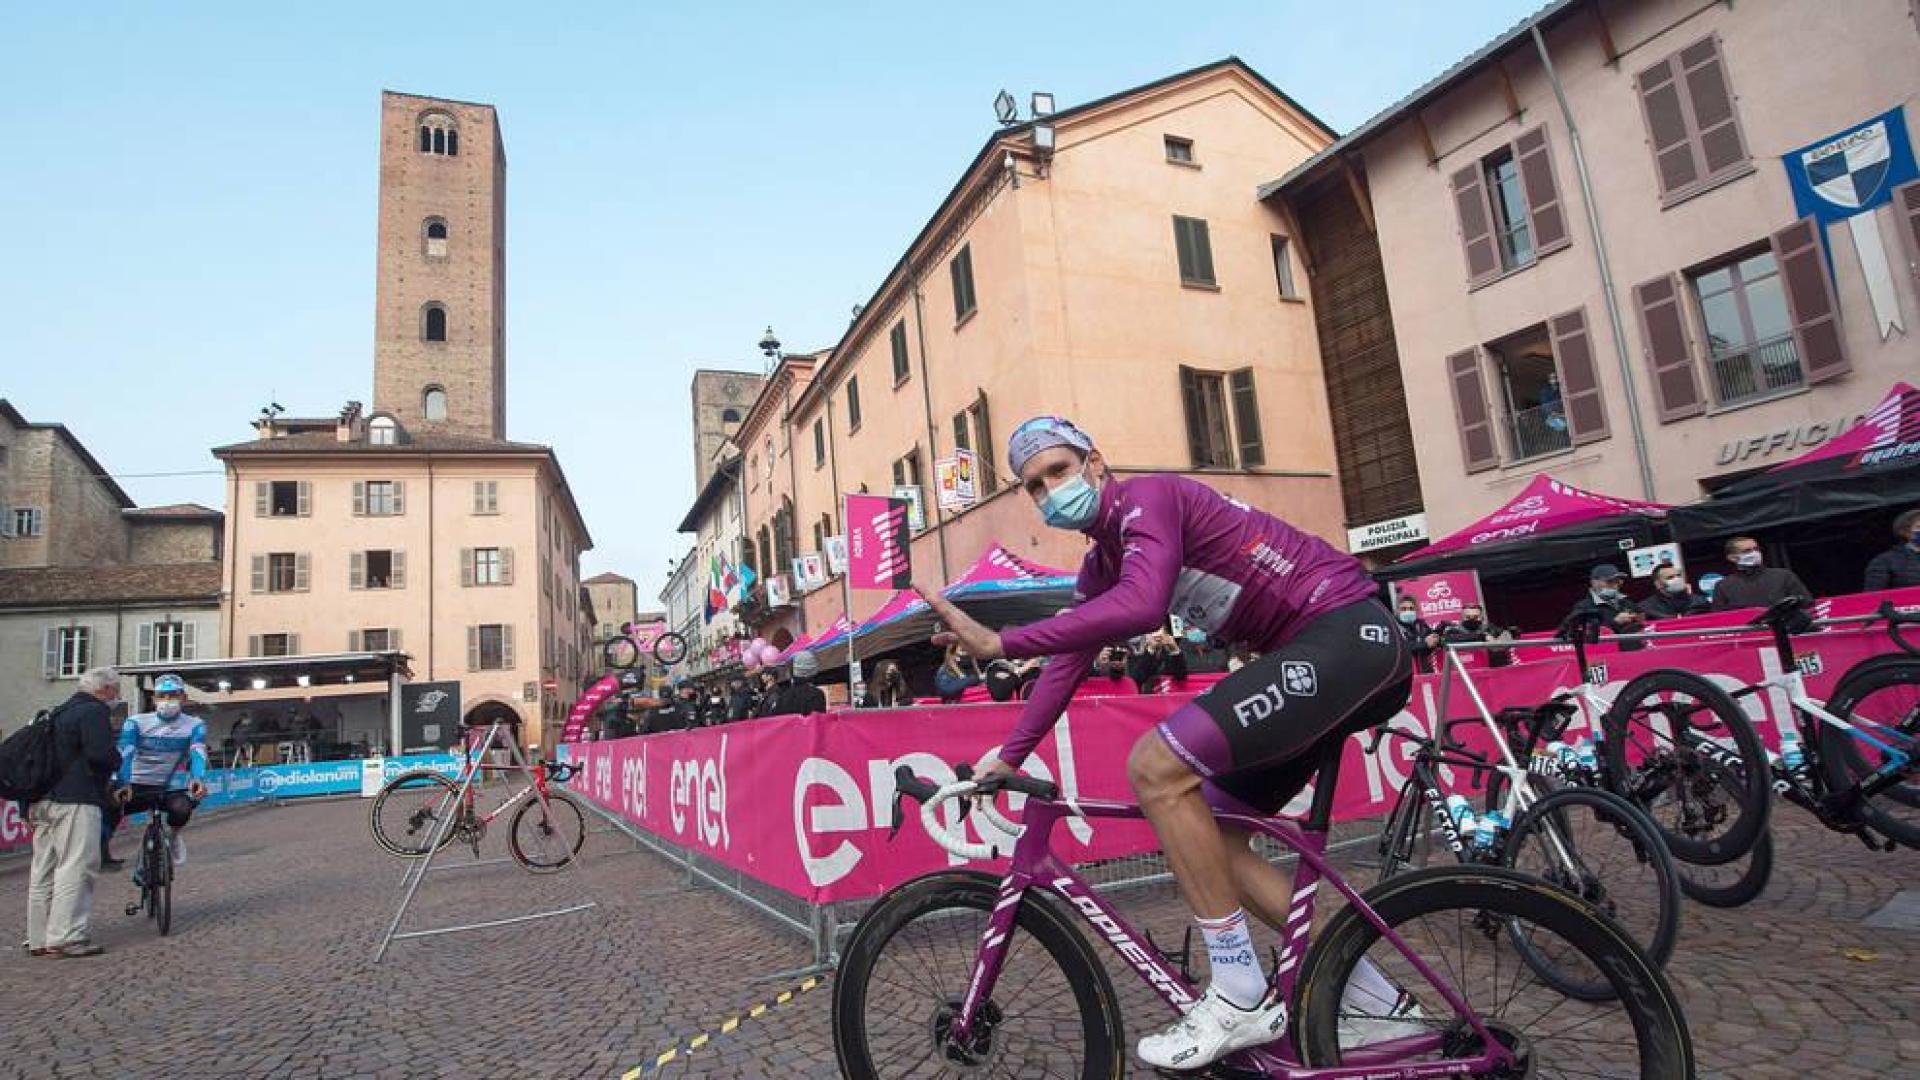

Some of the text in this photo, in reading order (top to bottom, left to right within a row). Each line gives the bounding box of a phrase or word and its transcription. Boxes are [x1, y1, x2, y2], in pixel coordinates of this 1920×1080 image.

[1361, 527, 1420, 548] MUNICIPALE
[1367, 519, 1408, 536] POLIZIA
[1232, 683, 1285, 728] FDJ
[257, 767, 359, 794] mediolanum
[621, 742, 648, 819] enel
[670, 733, 730, 850] enel
[794, 711, 1094, 887] enel
